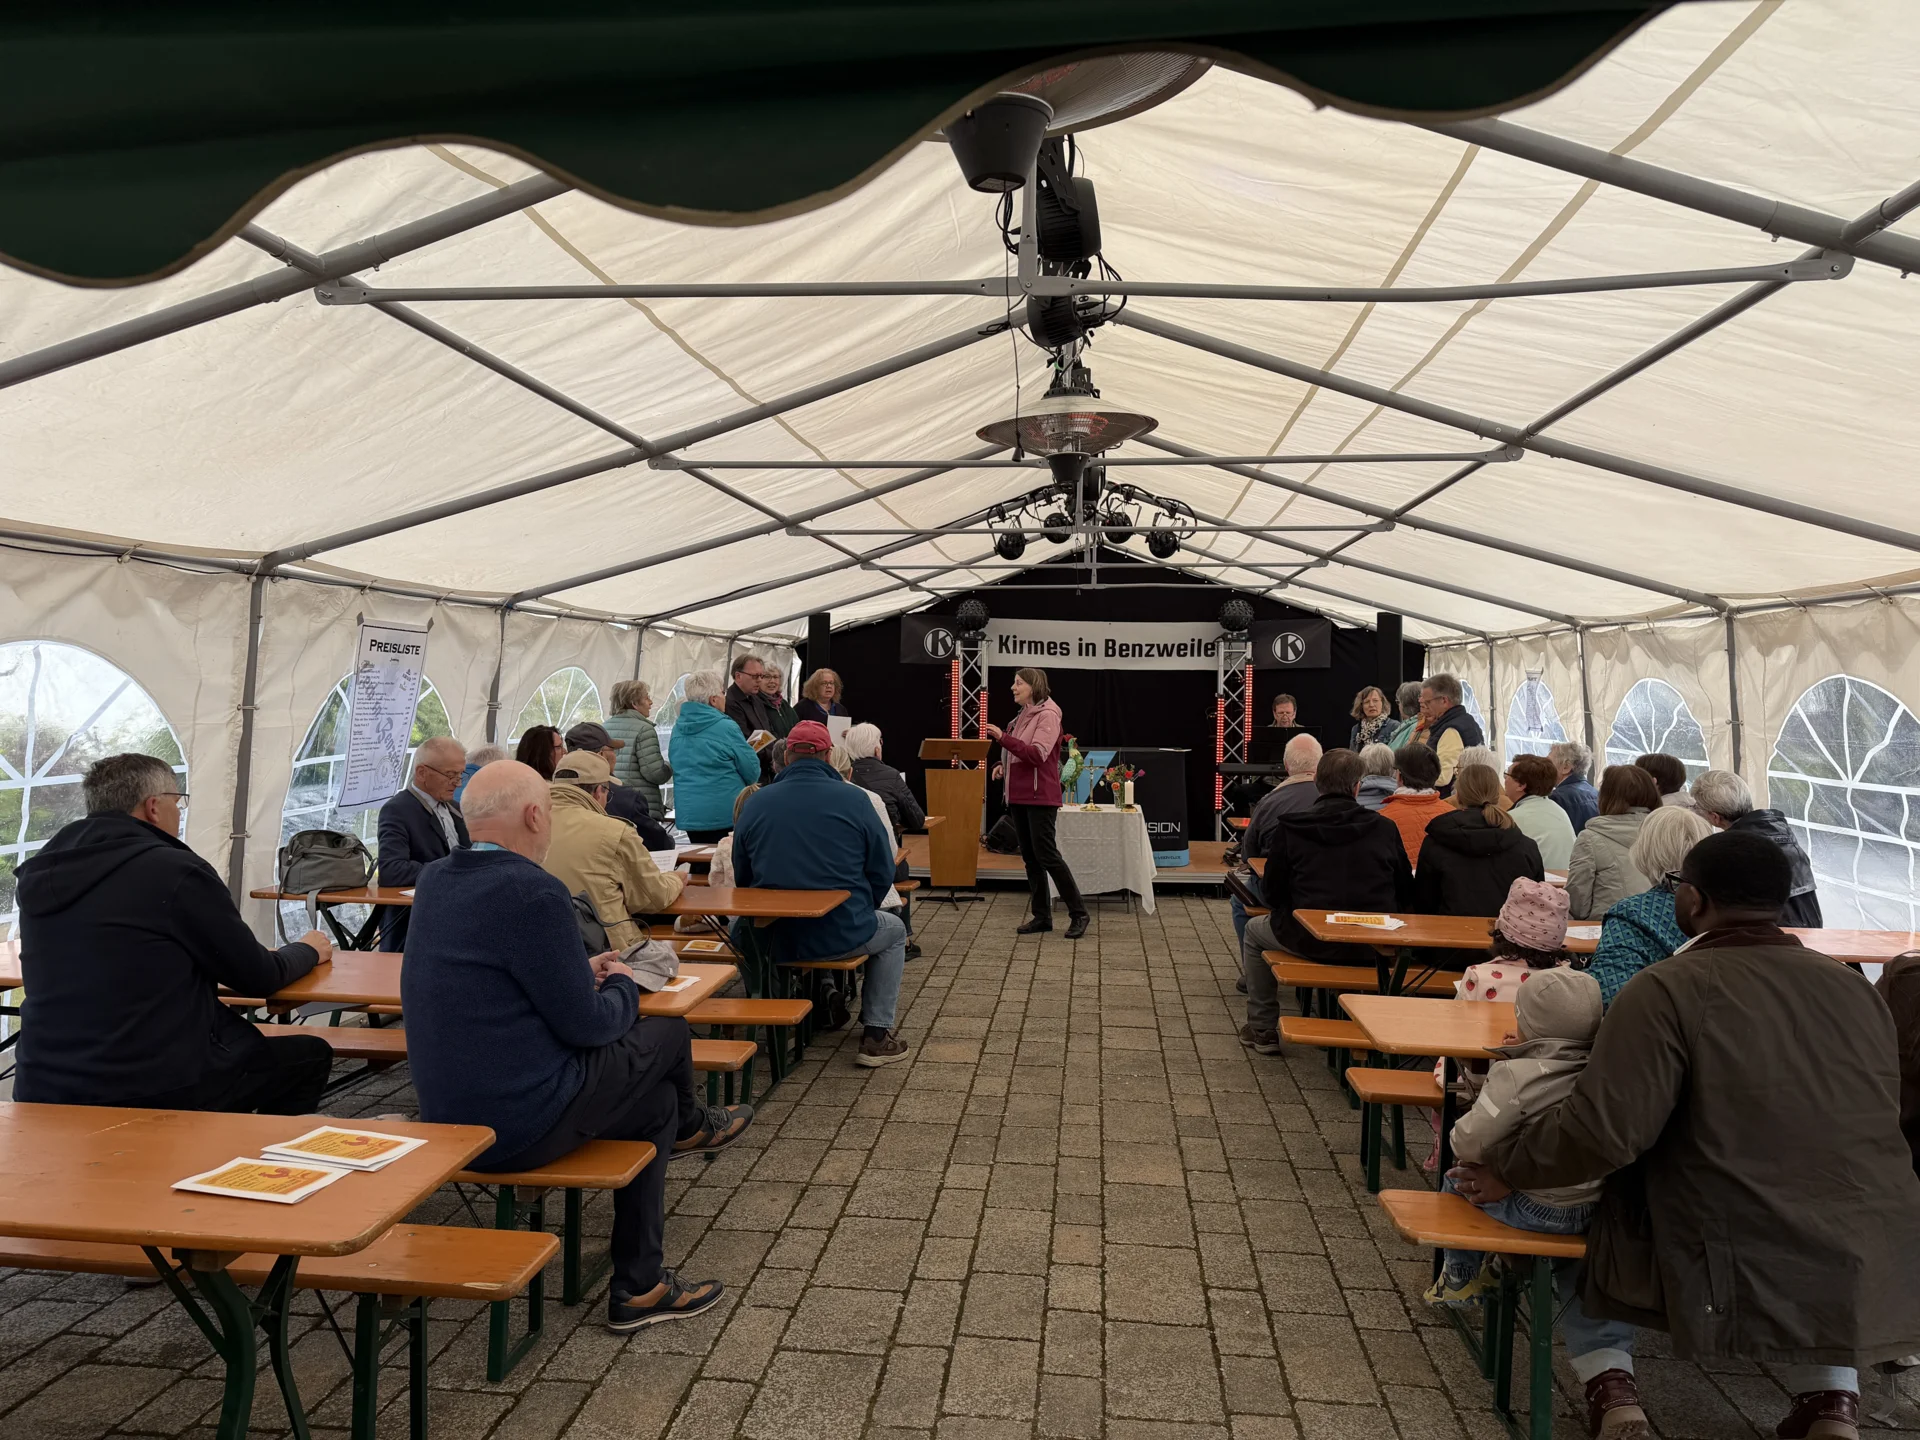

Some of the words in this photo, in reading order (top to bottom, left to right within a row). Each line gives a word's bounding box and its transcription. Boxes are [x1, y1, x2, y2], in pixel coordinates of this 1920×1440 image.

[369, 639, 421, 656] PREISLISTE
[997, 634, 1071, 657] Kirmes
[1077, 636, 1097, 658] in
[1104, 637, 1219, 659] Benzweile
